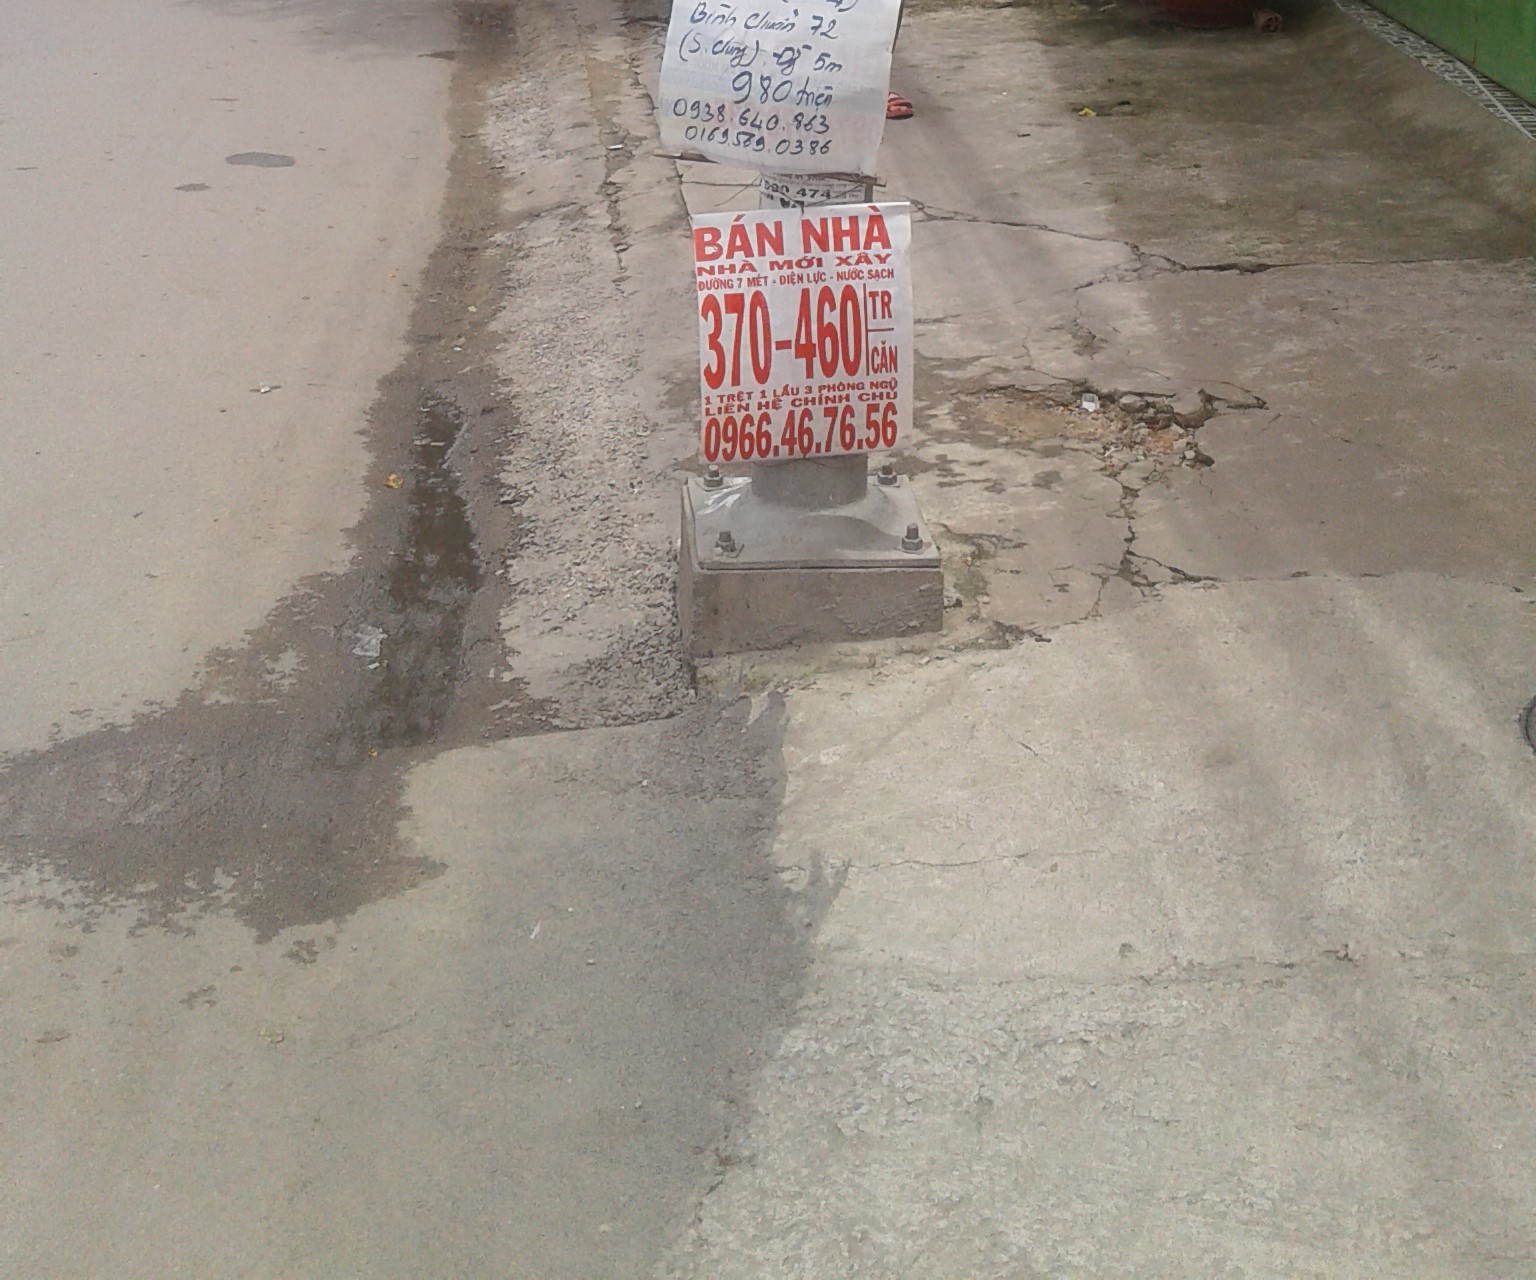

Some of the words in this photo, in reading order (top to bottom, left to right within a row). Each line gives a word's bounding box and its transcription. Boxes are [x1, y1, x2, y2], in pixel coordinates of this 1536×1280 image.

[810, 15, 839, 39] 72
[732, 70, 793, 104] 980
[694, 214, 785, 262] BÁN
[800, 205, 892, 254] NHÀ
[696, 259, 757, 276] NHÀ
[769, 256, 823, 271] MỚI
[836, 253, 893, 267] XÂY
[737, 279, 743, 289] 7
[747, 273, 768, 288] MÉT
[779, 272, 804, 287] ĐIỆN
[807, 272, 827, 286] LỰC
[836, 269, 865, 281] NƯỚC
[867, 268, 895, 282] SẠCH
[868, 290, 893, 320] TR
[870, 341, 898, 375] CĂN
[704, 396, 711, 406] 1
[717, 389, 755, 405] TRỆT
[760, 390, 768, 400] 1
[804, 385, 812, 395] 3
[817, 380, 865, 394] PHÒNG
[704, 401, 750, 417] LIÊN
[757, 396, 783, 411] HỆ
[790, 391, 850, 407] CHÍNH
[703, 401, 898, 462] 0966.46.76.56
